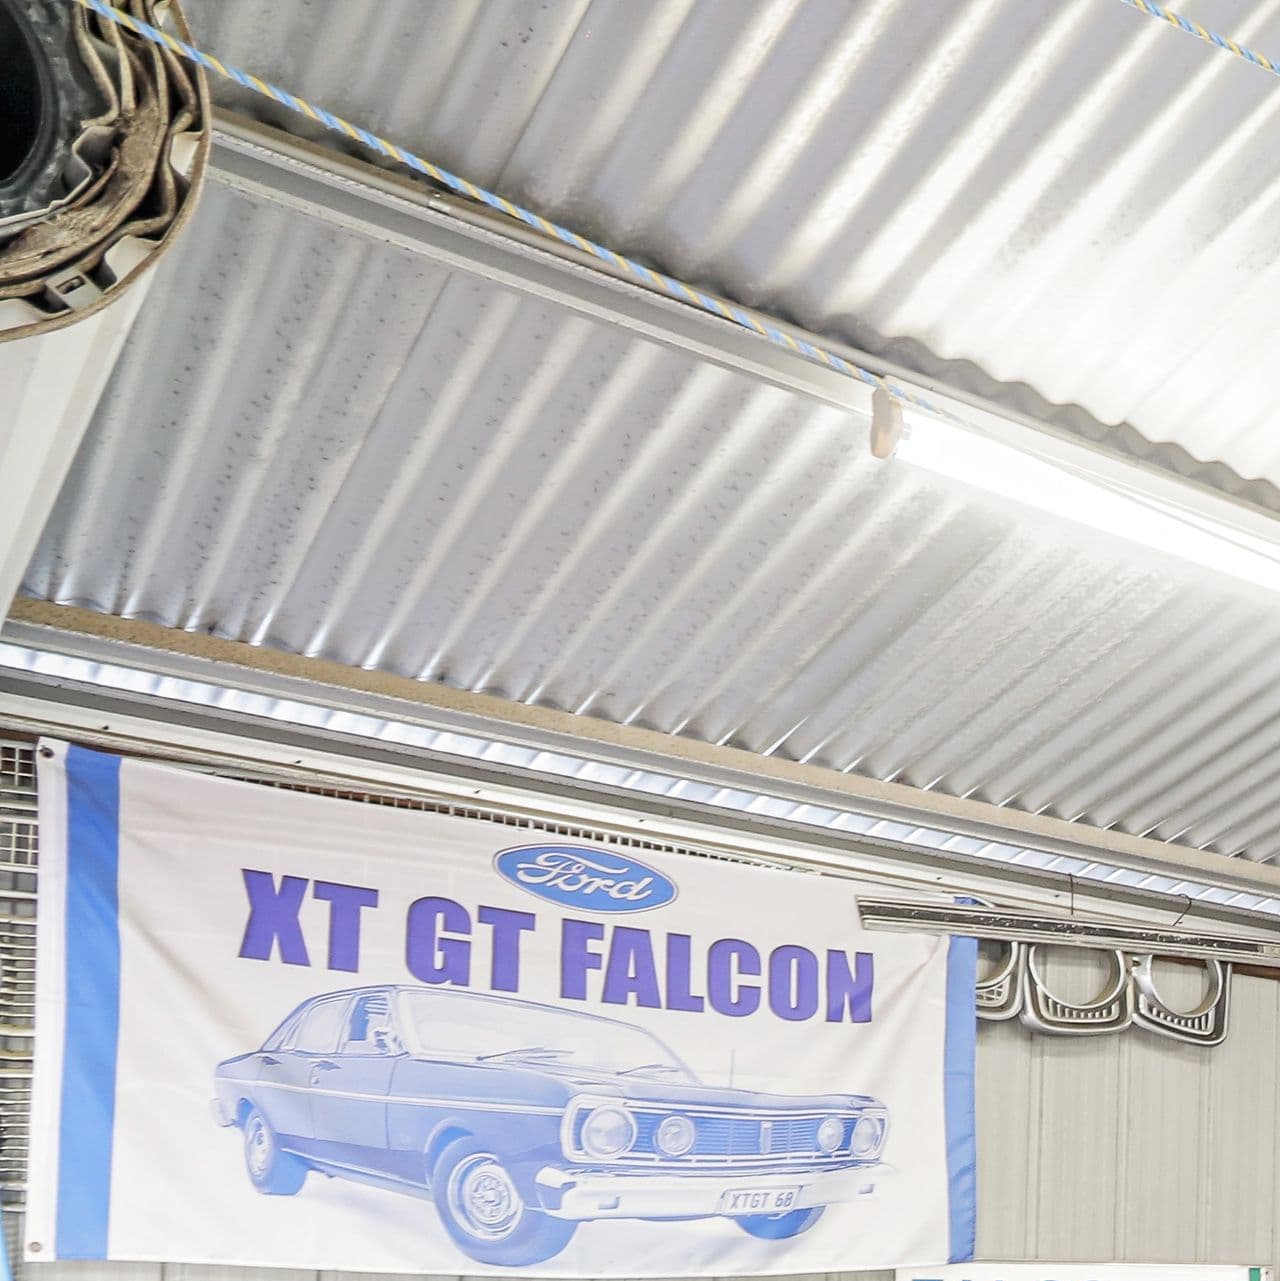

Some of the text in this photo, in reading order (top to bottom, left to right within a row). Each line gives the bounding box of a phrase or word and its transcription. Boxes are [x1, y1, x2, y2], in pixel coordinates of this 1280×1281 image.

[516, 852, 653, 900] Ford
[239, 868, 874, 1023] XT GT FALCON
